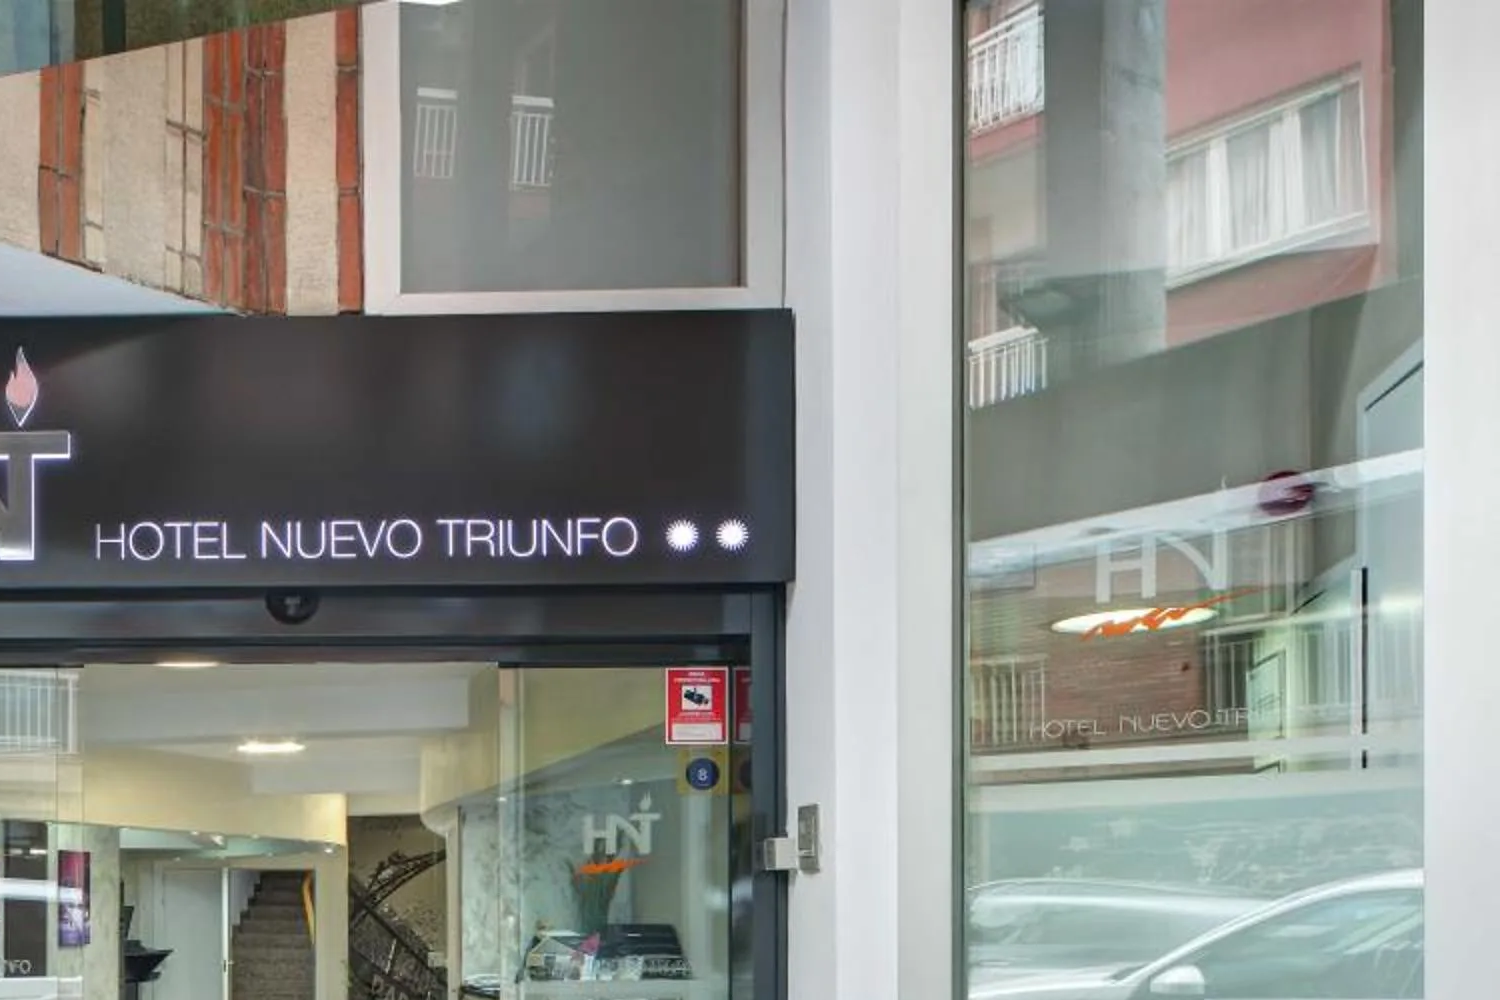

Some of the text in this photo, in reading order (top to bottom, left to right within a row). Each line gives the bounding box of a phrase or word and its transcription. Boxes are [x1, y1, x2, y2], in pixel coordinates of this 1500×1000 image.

[96, 517, 638, 560] HOTEL NUEVO TRIUNFO
[1029, 718, 1106, 741] HOTEL
[1118, 709, 1211, 733] NUEVO
